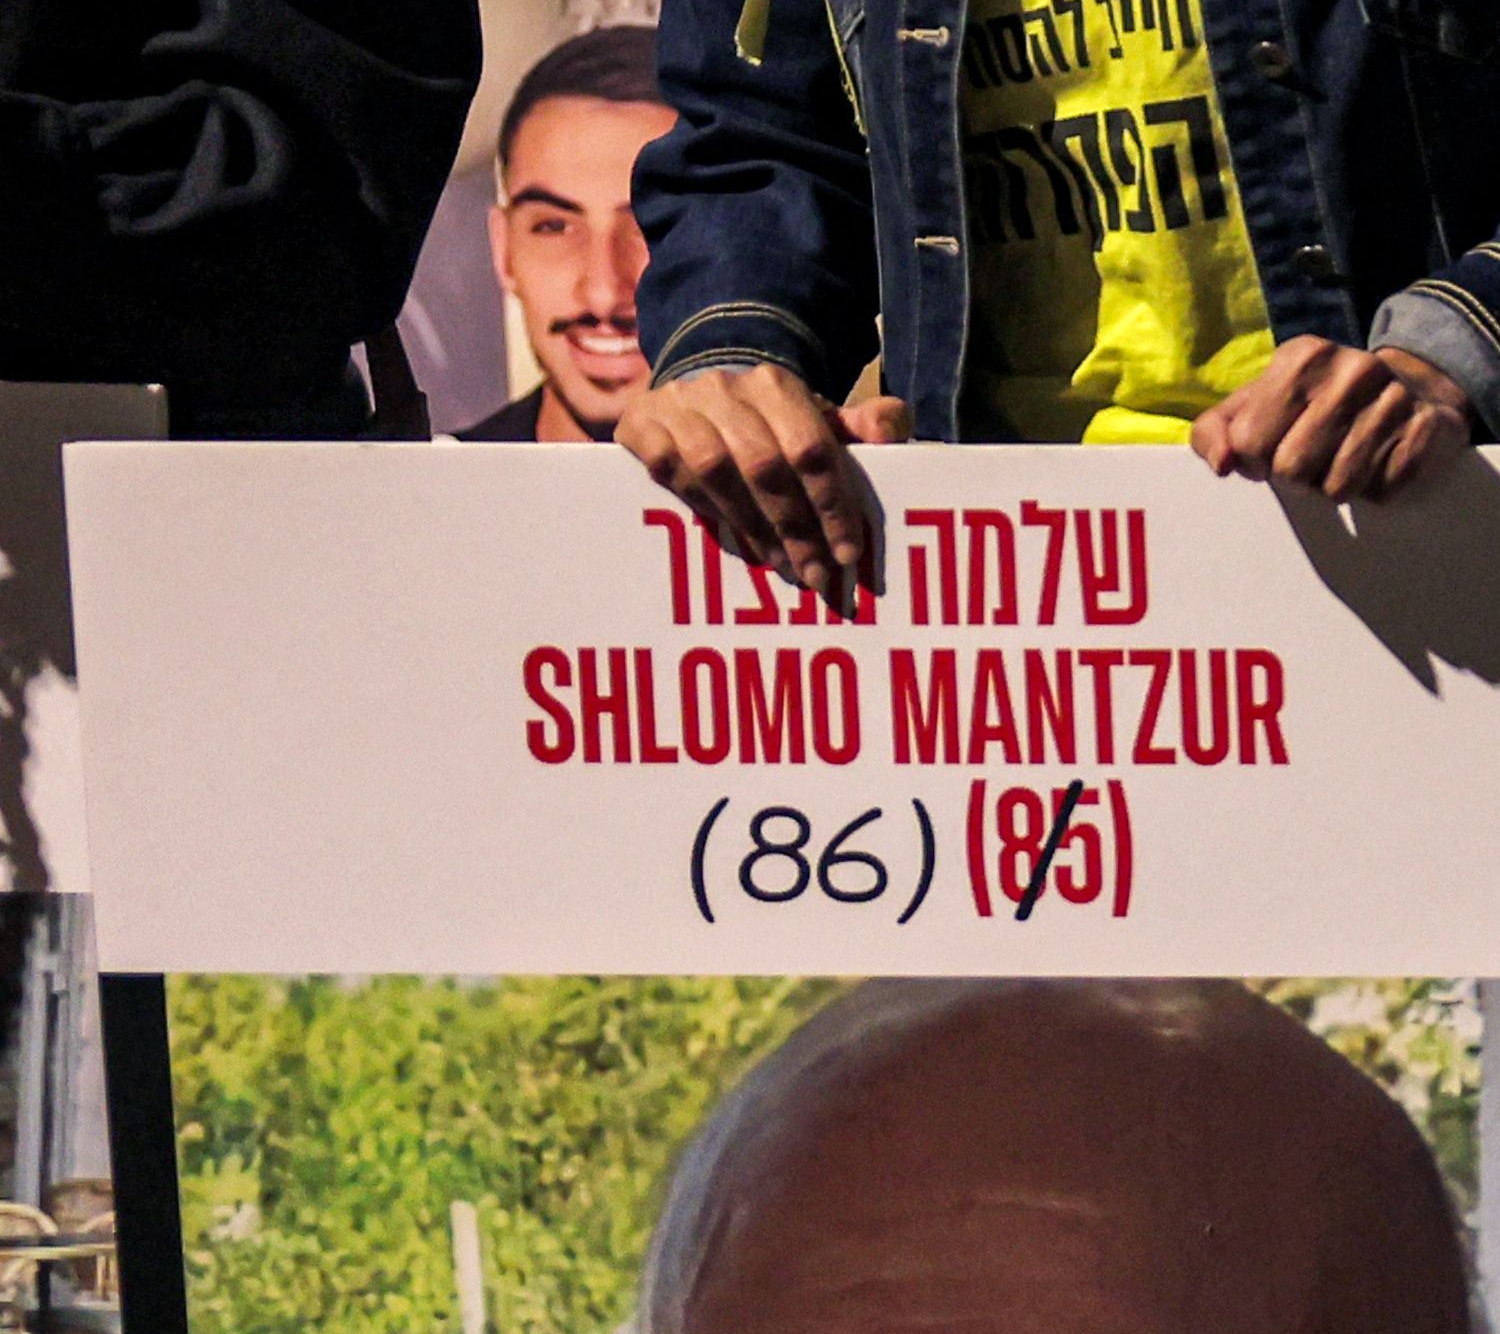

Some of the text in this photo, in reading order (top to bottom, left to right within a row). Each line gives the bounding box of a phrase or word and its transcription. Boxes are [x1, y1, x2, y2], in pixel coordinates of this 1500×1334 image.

[904, 499, 1149, 626] שלמה
[523, 644, 1291, 767] SHLOMO MANTZUR
[690, 777, 1134, 925] (86) (85)
